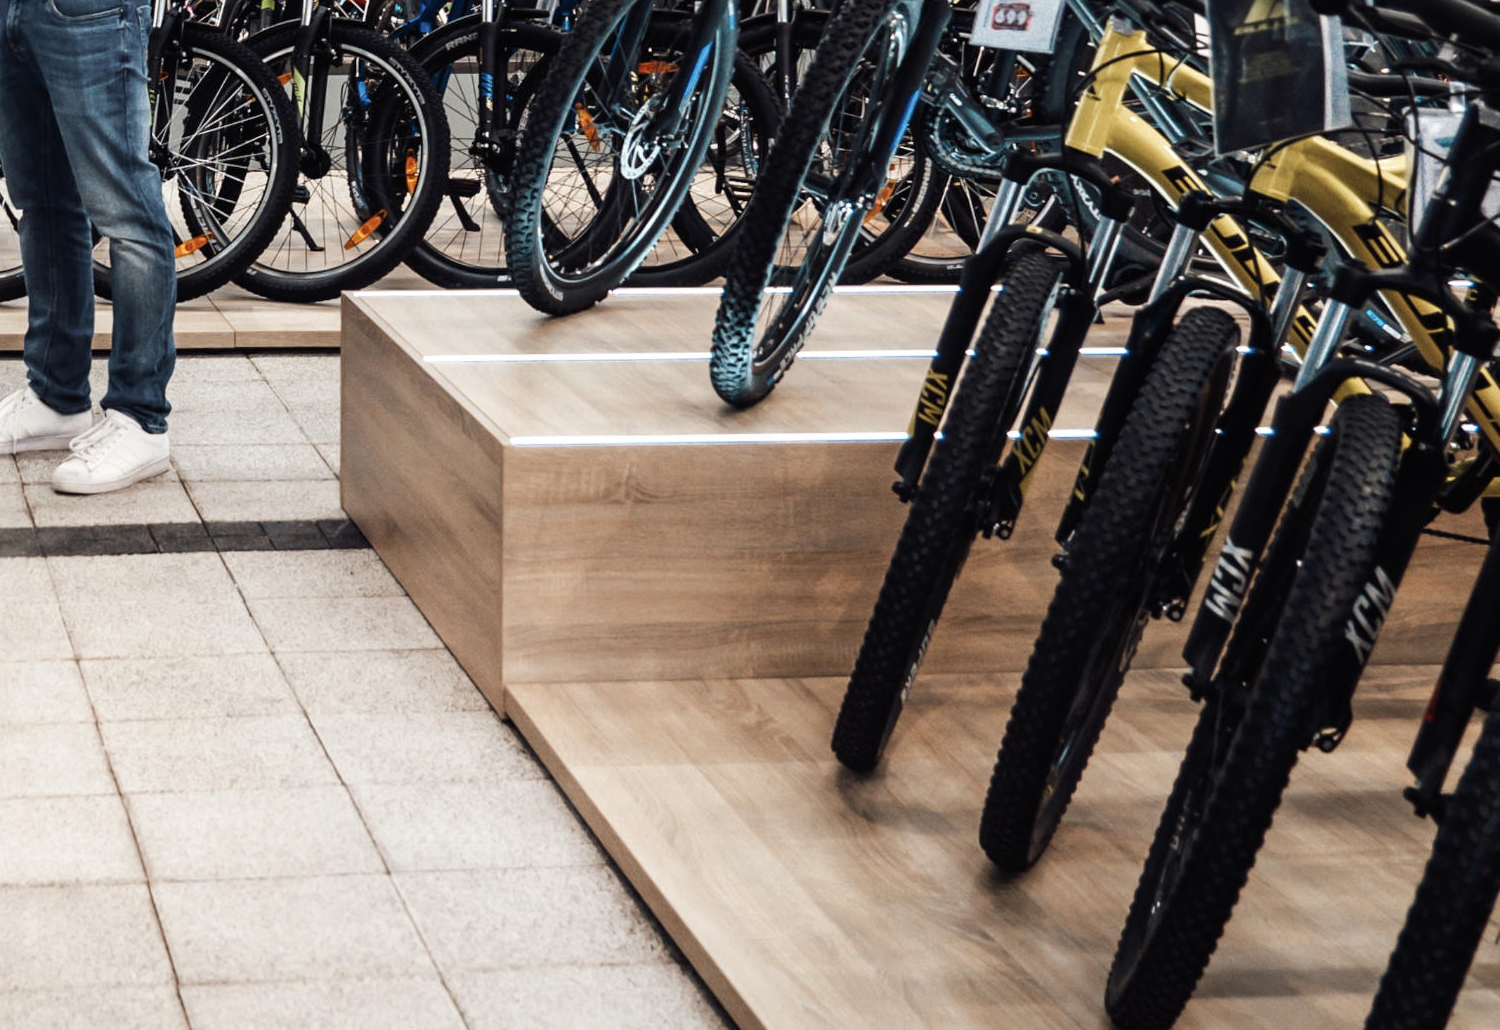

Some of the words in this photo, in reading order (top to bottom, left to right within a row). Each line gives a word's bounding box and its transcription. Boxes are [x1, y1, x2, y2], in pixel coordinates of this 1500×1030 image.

[917, 369, 949, 426] XCM
[1012, 406, 1052, 475] XCM
[1204, 535, 1253, 625] XCM
[1345, 566, 1397, 665] XCM
